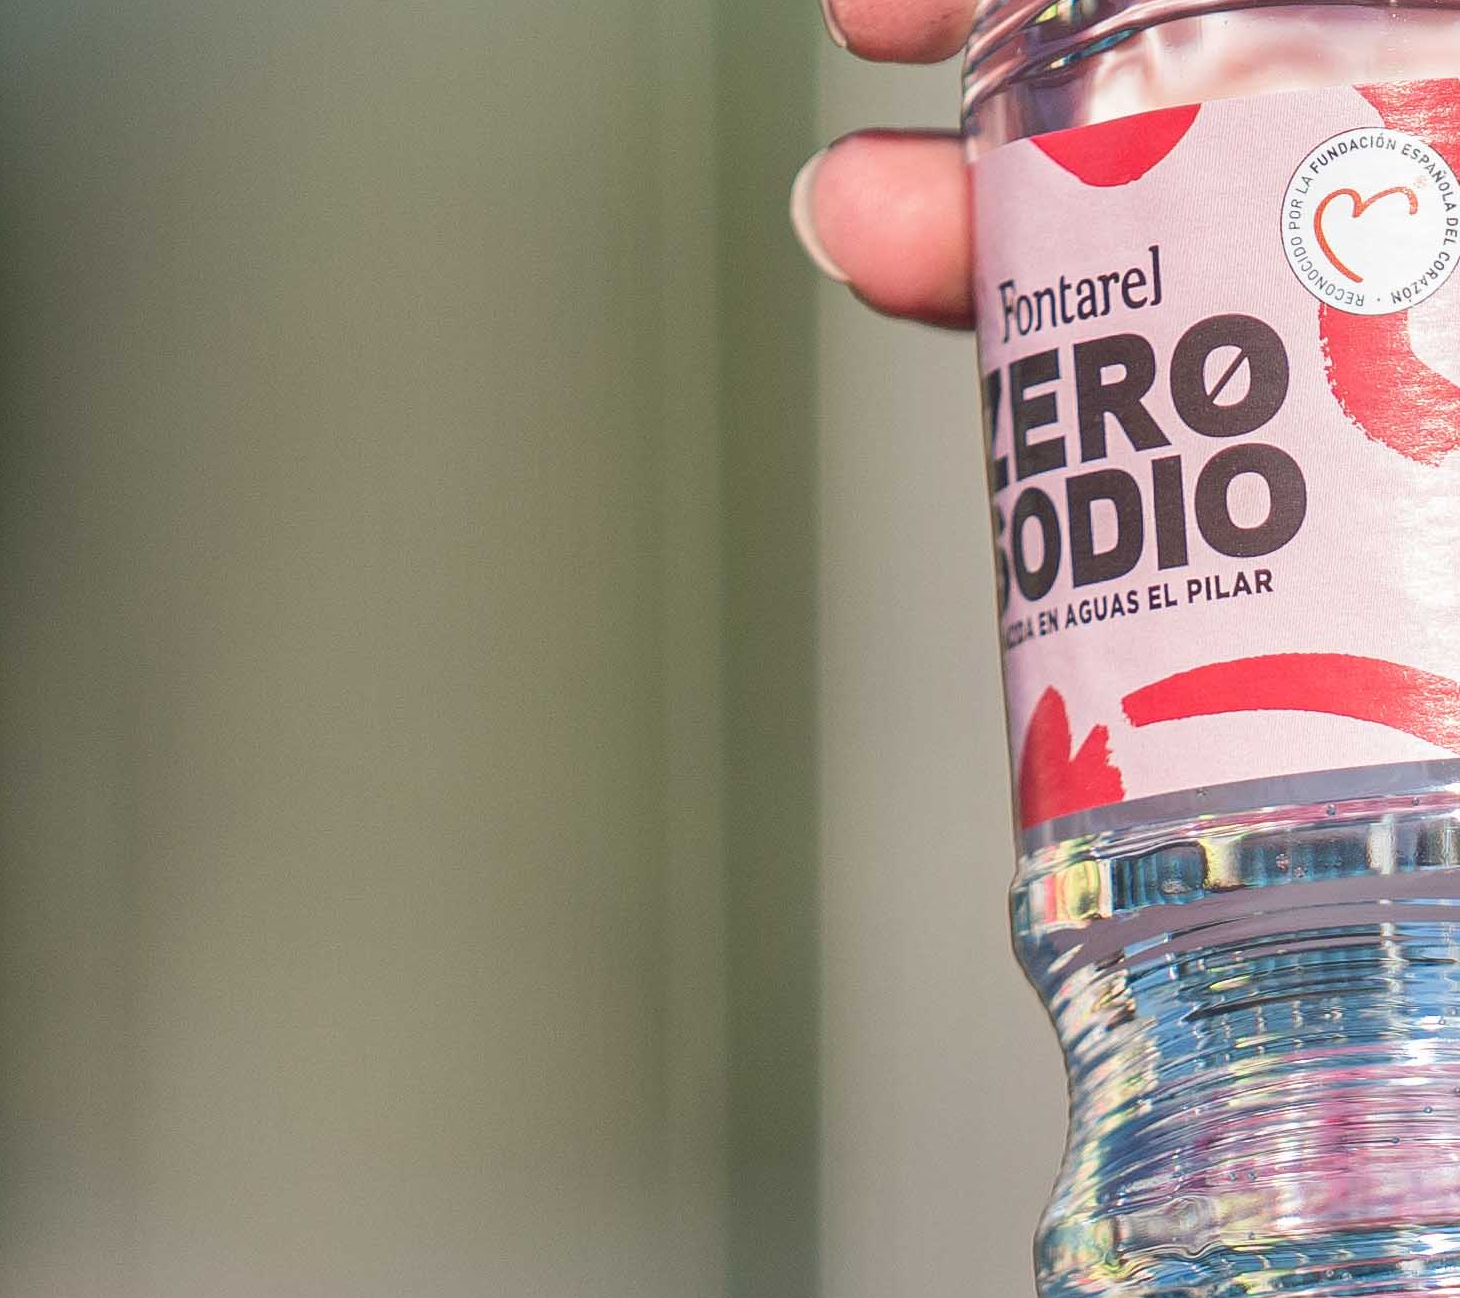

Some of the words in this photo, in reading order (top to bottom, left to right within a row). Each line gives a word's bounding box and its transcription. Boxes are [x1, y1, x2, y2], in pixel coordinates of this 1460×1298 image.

[1309, 133, 1396, 174] FUNDACIÓN
[1401, 143, 1457, 213] ESPAÑOLA
[1295, 175, 1313, 195] LA
[1288, 199, 1303, 230] POR
[1443, 217, 1459, 246] DEL
[998, 245, 1162, 343] Fontarel
[1289, 235, 1365, 307] RECONOCIDO
[1390, 251, 1451, 304] CORAZÓN
[1039, 607, 1058, 636] EN
[1065, 588, 1140, 630] AGUAS
[1148, 582, 1180, 611] EL
[1188, 568, 1274, 604] PILAR
